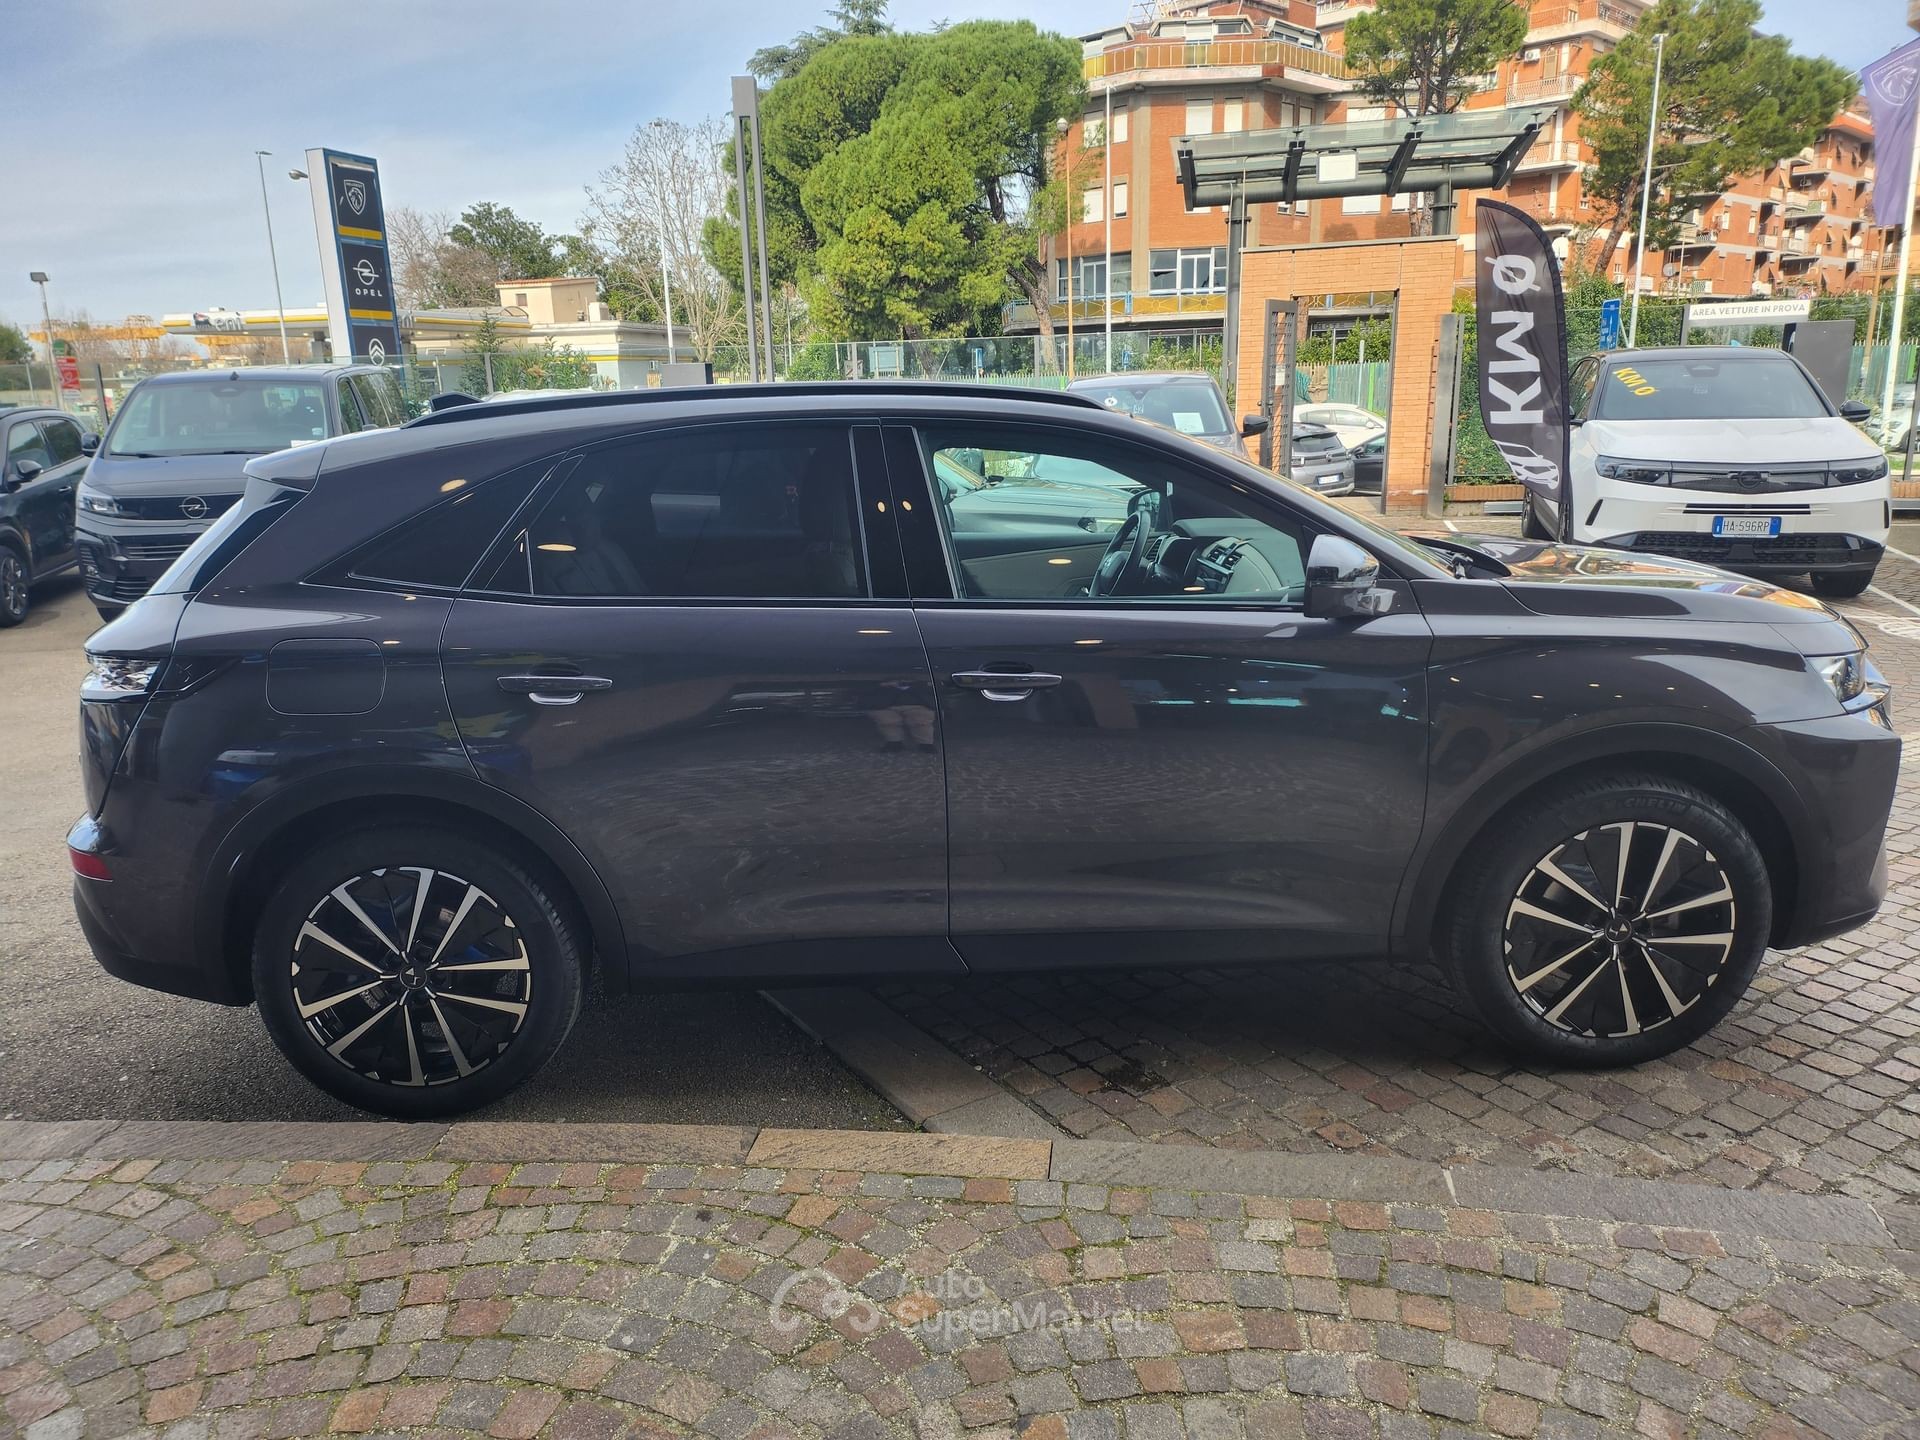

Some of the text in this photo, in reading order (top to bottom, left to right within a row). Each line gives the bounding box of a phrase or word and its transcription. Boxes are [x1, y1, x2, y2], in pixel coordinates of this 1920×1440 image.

[355, 288, 382, 297] OPEL
[1719, 306, 1759, 315] VETTURE
[1761, 305, 1771, 313] IN
[1773, 303, 1805, 313] PROVA
[215, 312, 242, 331] eni
